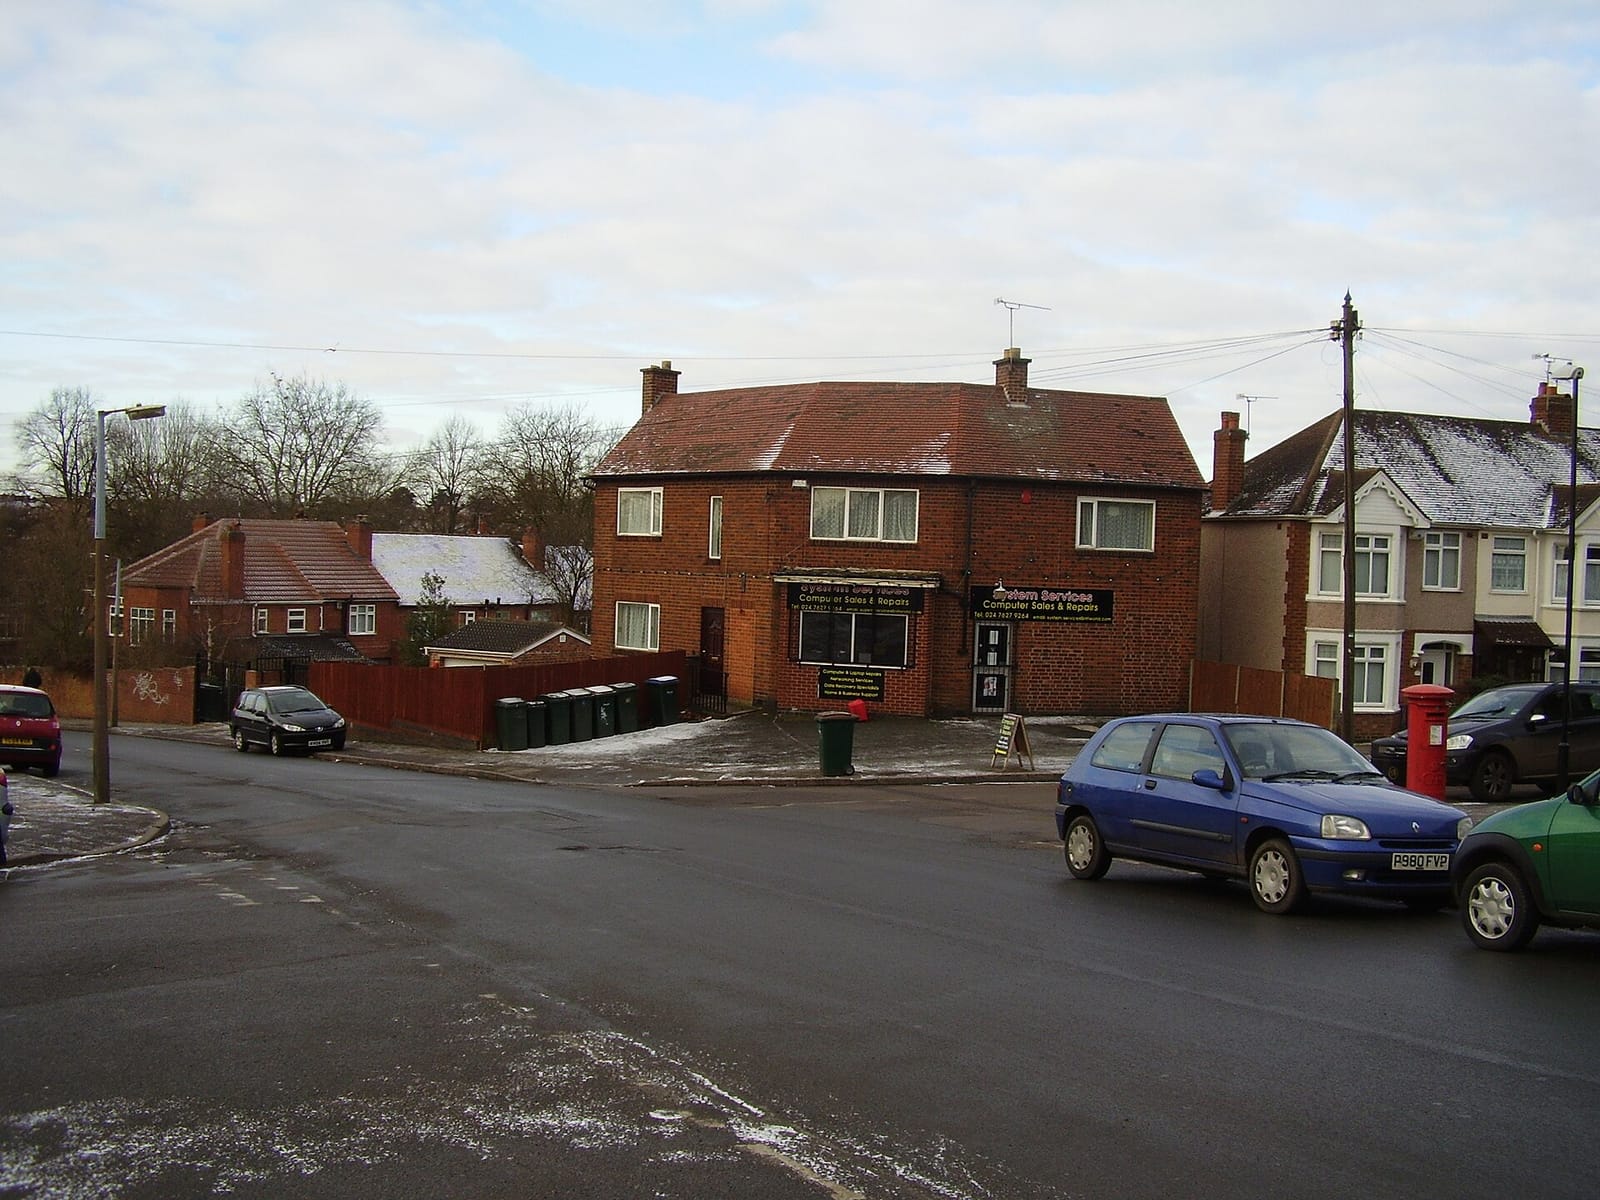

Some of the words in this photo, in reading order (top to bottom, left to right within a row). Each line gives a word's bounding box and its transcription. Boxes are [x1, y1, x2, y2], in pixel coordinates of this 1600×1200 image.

[799, 593, 842, 605] Compuer
[844, 595, 867, 604] Sales
[878, 597, 910, 606] Repairs
[1041, 590, 1093, 602] Services
[983, 600, 1029, 610] Computer
[1031, 601, 1055, 610] Sales
[1057, 602, 1064, 610] &
[1066, 602, 1099, 613] Repairs
[1394, 854, 1424, 867] P980
[1426, 855, 1447, 868] FVP
